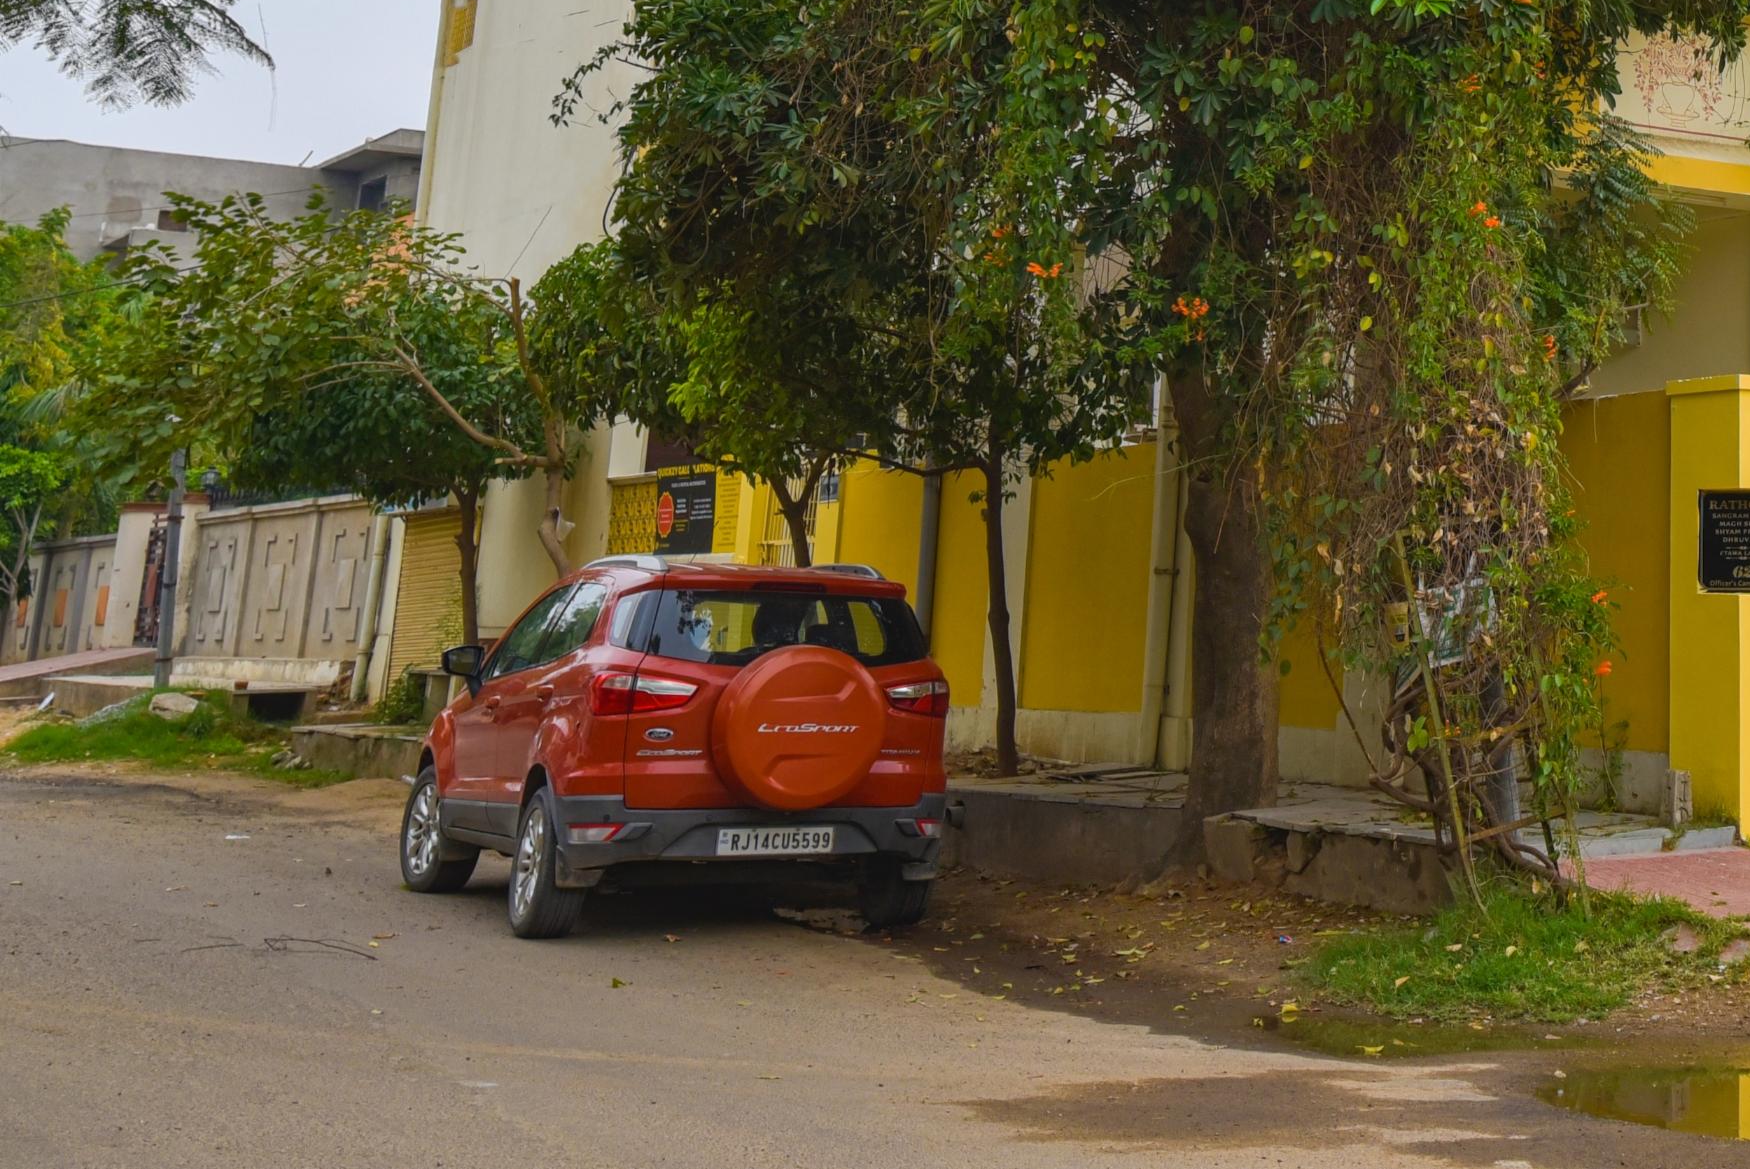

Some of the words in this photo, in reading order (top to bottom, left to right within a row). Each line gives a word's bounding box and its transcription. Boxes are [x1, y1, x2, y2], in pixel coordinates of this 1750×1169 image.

[678, 463, 716, 475] CALCLATIONS
[1710, 579, 1737, 587] Officer's
[730, 831, 831, 851] RJ14CU5599
